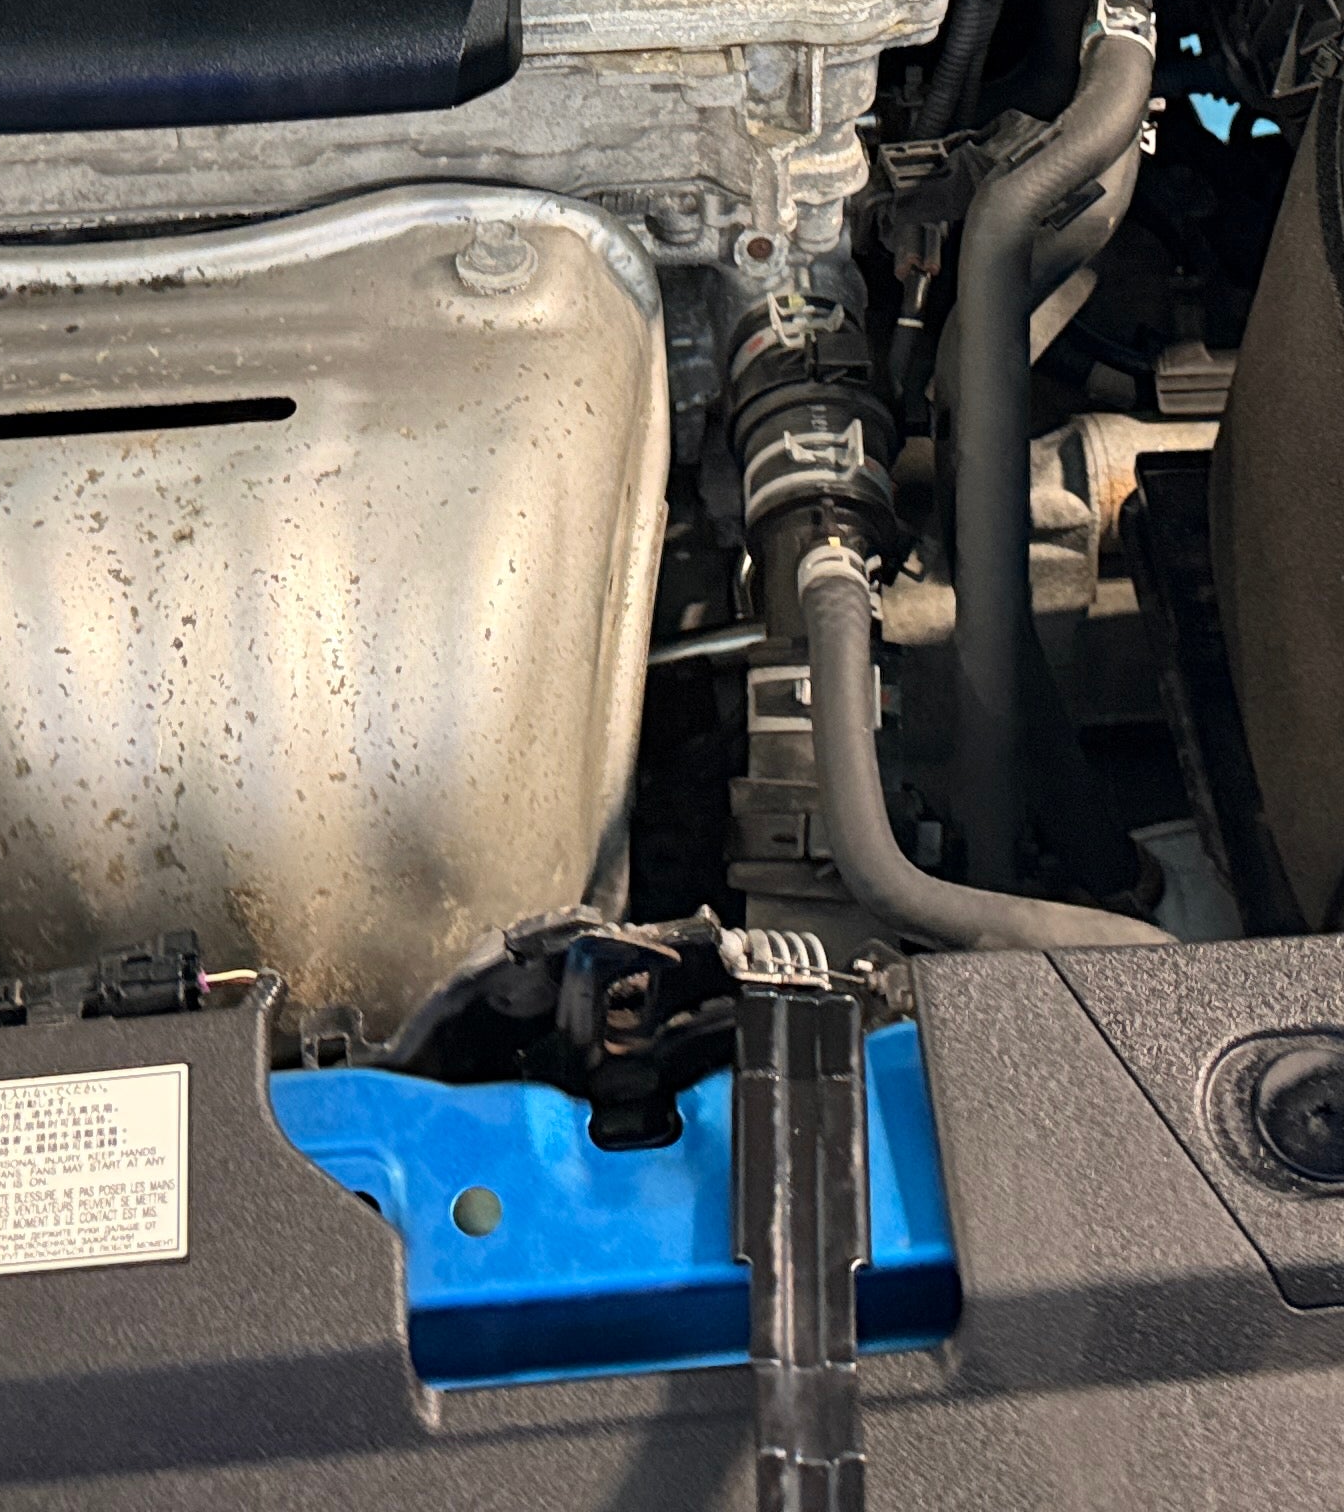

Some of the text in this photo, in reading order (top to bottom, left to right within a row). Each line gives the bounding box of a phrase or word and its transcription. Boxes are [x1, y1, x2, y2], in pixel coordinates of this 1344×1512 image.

[120, 1146, 157, 1158] HANDS
[62, 1163, 83, 1174] MAY
[145, 1156, 166, 1167] ANY
[79, 1185, 95, 1197] PAS
[98, 1182, 127, 1196] POSER
[78, 1209, 119, 1225] CONTACT
[122, 1207, 138, 1221] EST
